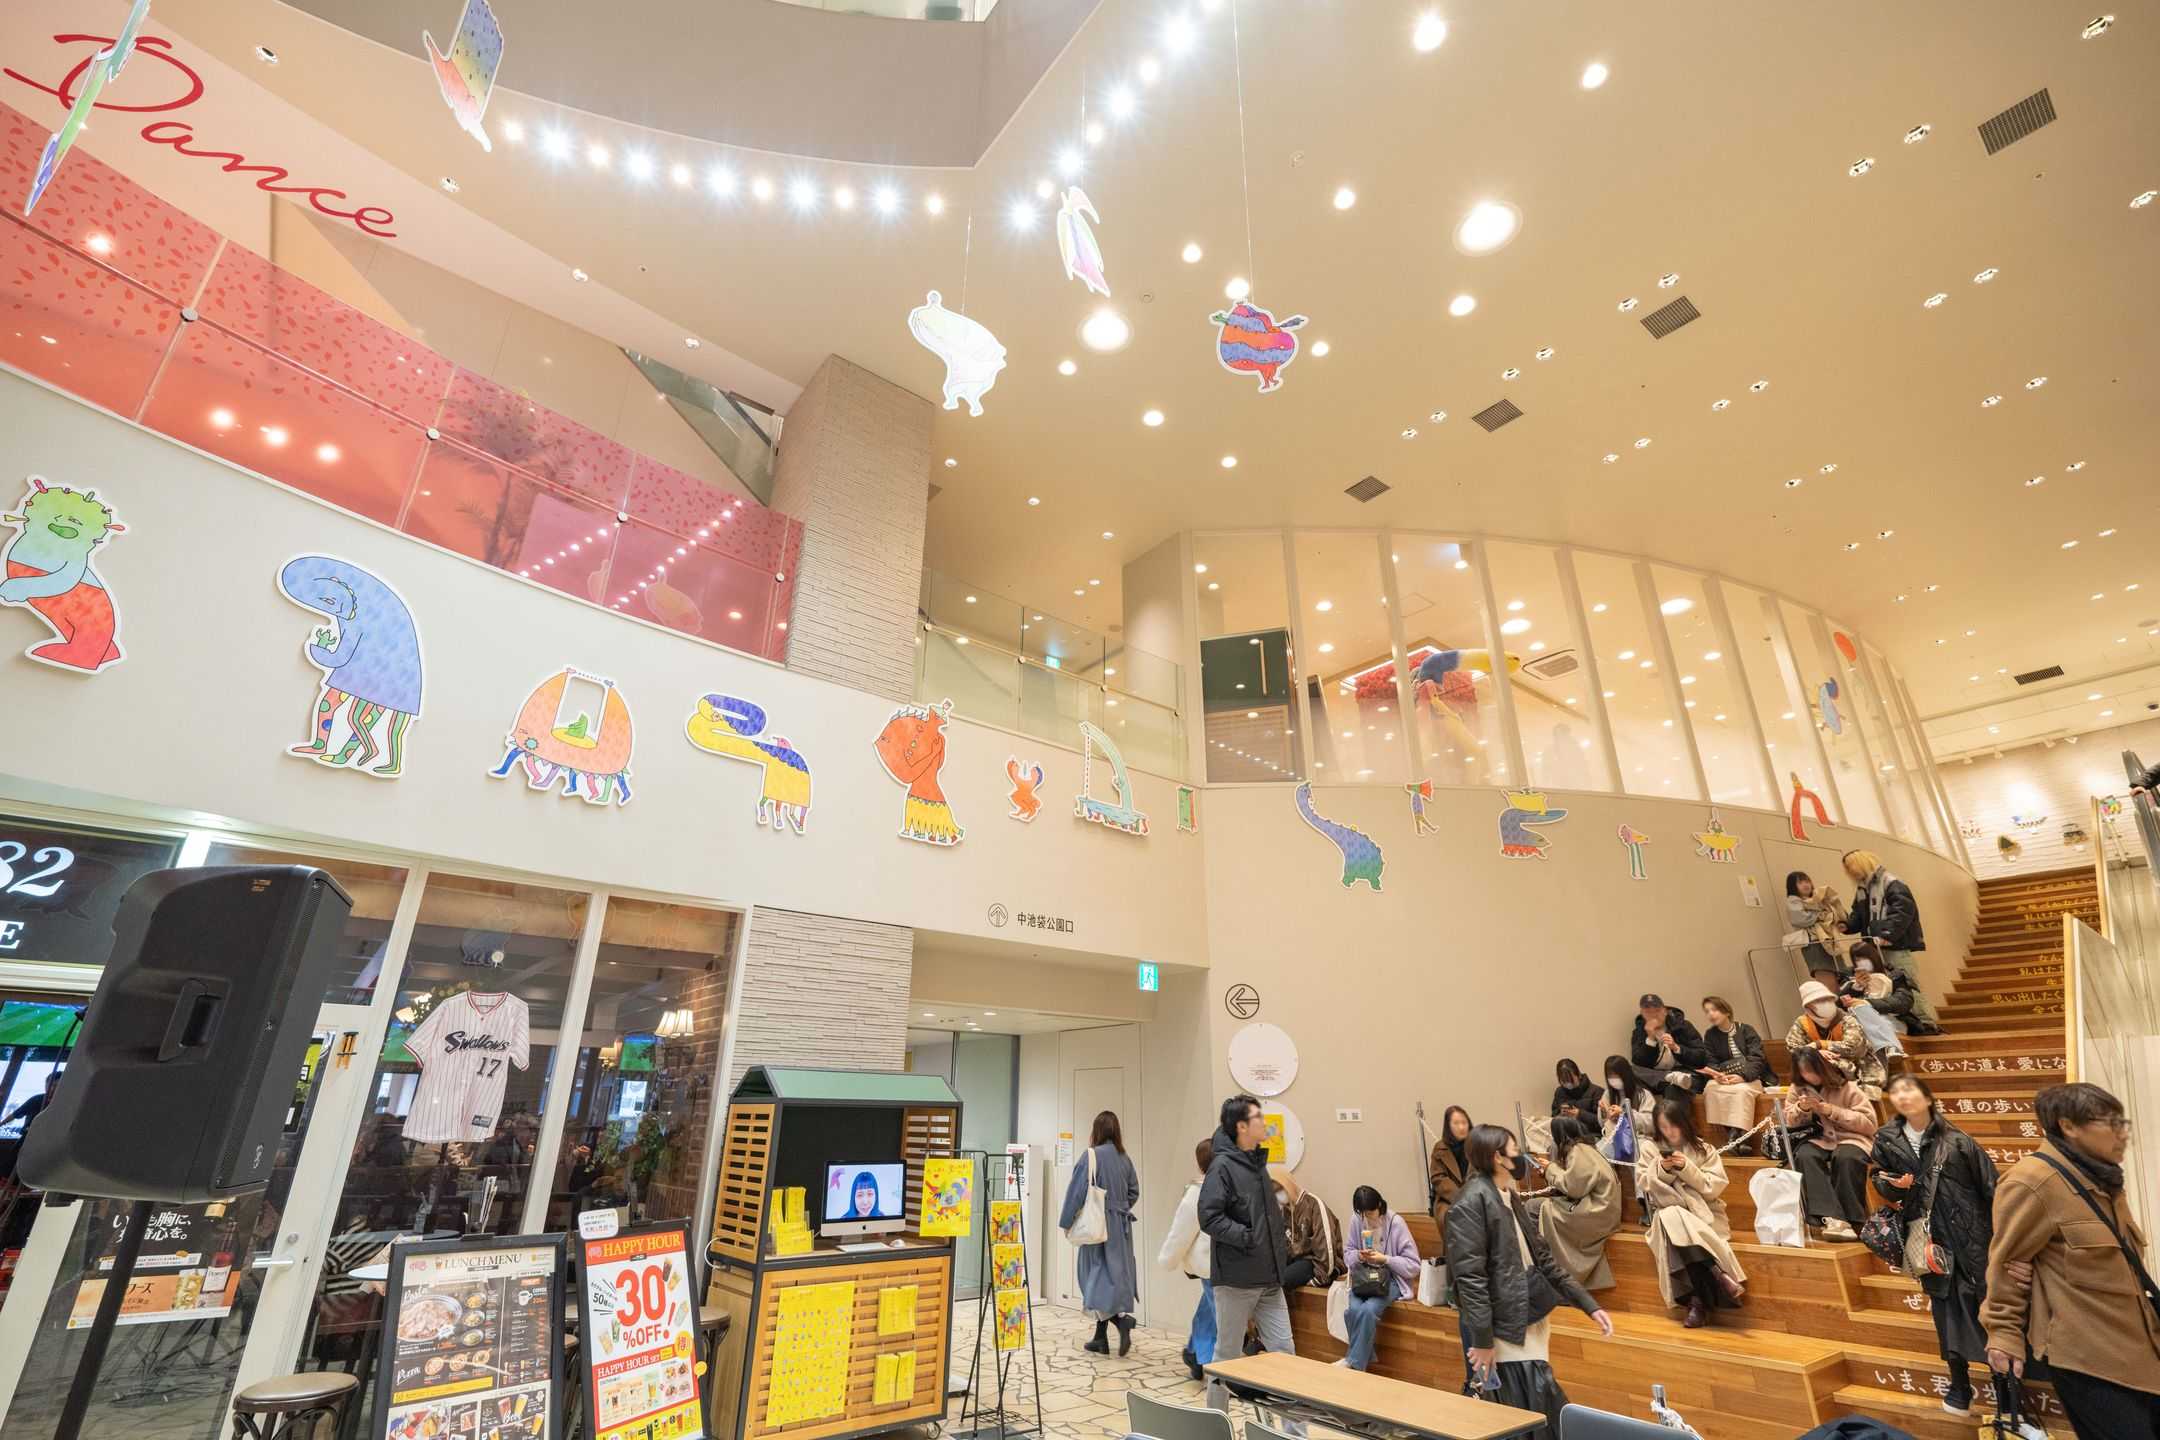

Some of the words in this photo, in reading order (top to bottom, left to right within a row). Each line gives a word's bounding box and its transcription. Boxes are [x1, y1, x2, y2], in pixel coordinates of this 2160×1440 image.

[3, 34, 397, 237] Dance
[1017, 911, 1073, 933] 中池袋公園口
[444, 1030, 512, 1054] Swallows
[477, 1057, 502, 1080] 17
[2019, 1121, 2046, 1137] 愛
[603, 1238, 645, 1257] HAPPY
[647, 1233, 681, 1251] HOUR
[444, 1256, 487, 1270] LUNCH
[487, 1253, 522, 1266] MENU
[616, 1265, 666, 1327] 30
[597, 1361, 626, 1378] HAPPY
[626, 1354, 650, 1370] HOUR
